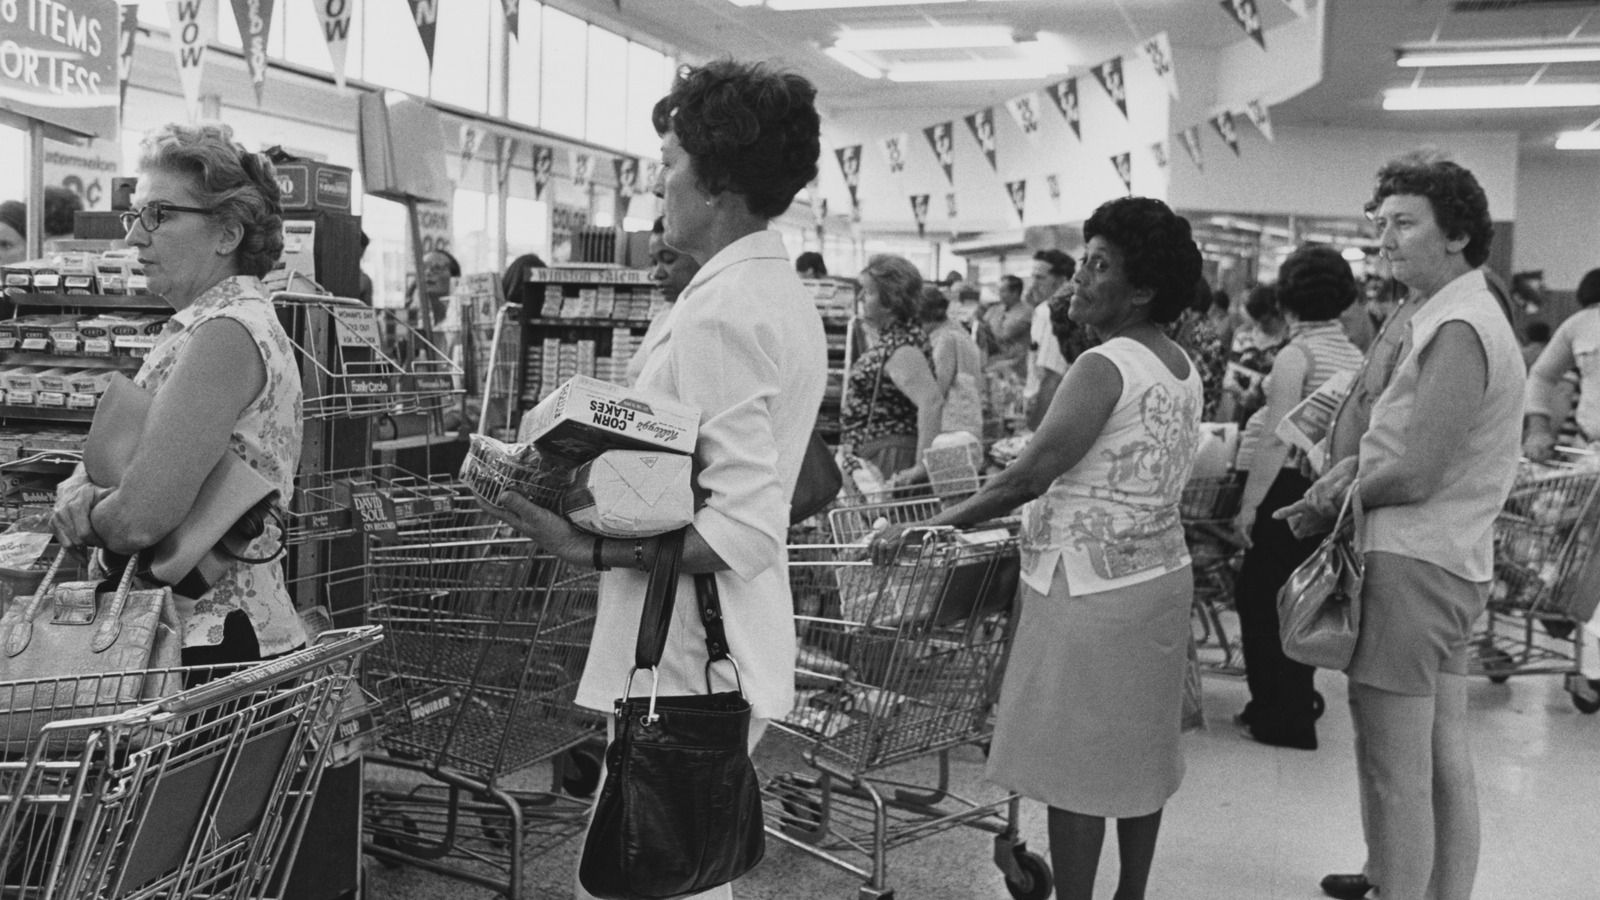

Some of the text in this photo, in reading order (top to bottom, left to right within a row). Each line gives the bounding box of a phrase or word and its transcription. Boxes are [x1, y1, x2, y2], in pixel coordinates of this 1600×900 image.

[29, 0, 102, 57] ITEMS
[178, 1, 202, 68] WOW
[325, 0, 352, 43] OW
[0, 40, 102, 97] OR LESS
[1145, 41, 1169, 77] WOW
[1016, 98, 1038, 134] WOW
[886, 138, 904, 173] WOW
[538, 269, 591, 282] Winston
[599, 270, 640, 283] Salem
[590, 400, 635, 421] FLAKES
[593, 412, 627, 431] CORN
[636, 420, 679, 442] Kellogg's
[353, 496, 382, 510] DAVID
[361, 509, 388, 522] SOUL
[241, 668, 268, 683] STAR
